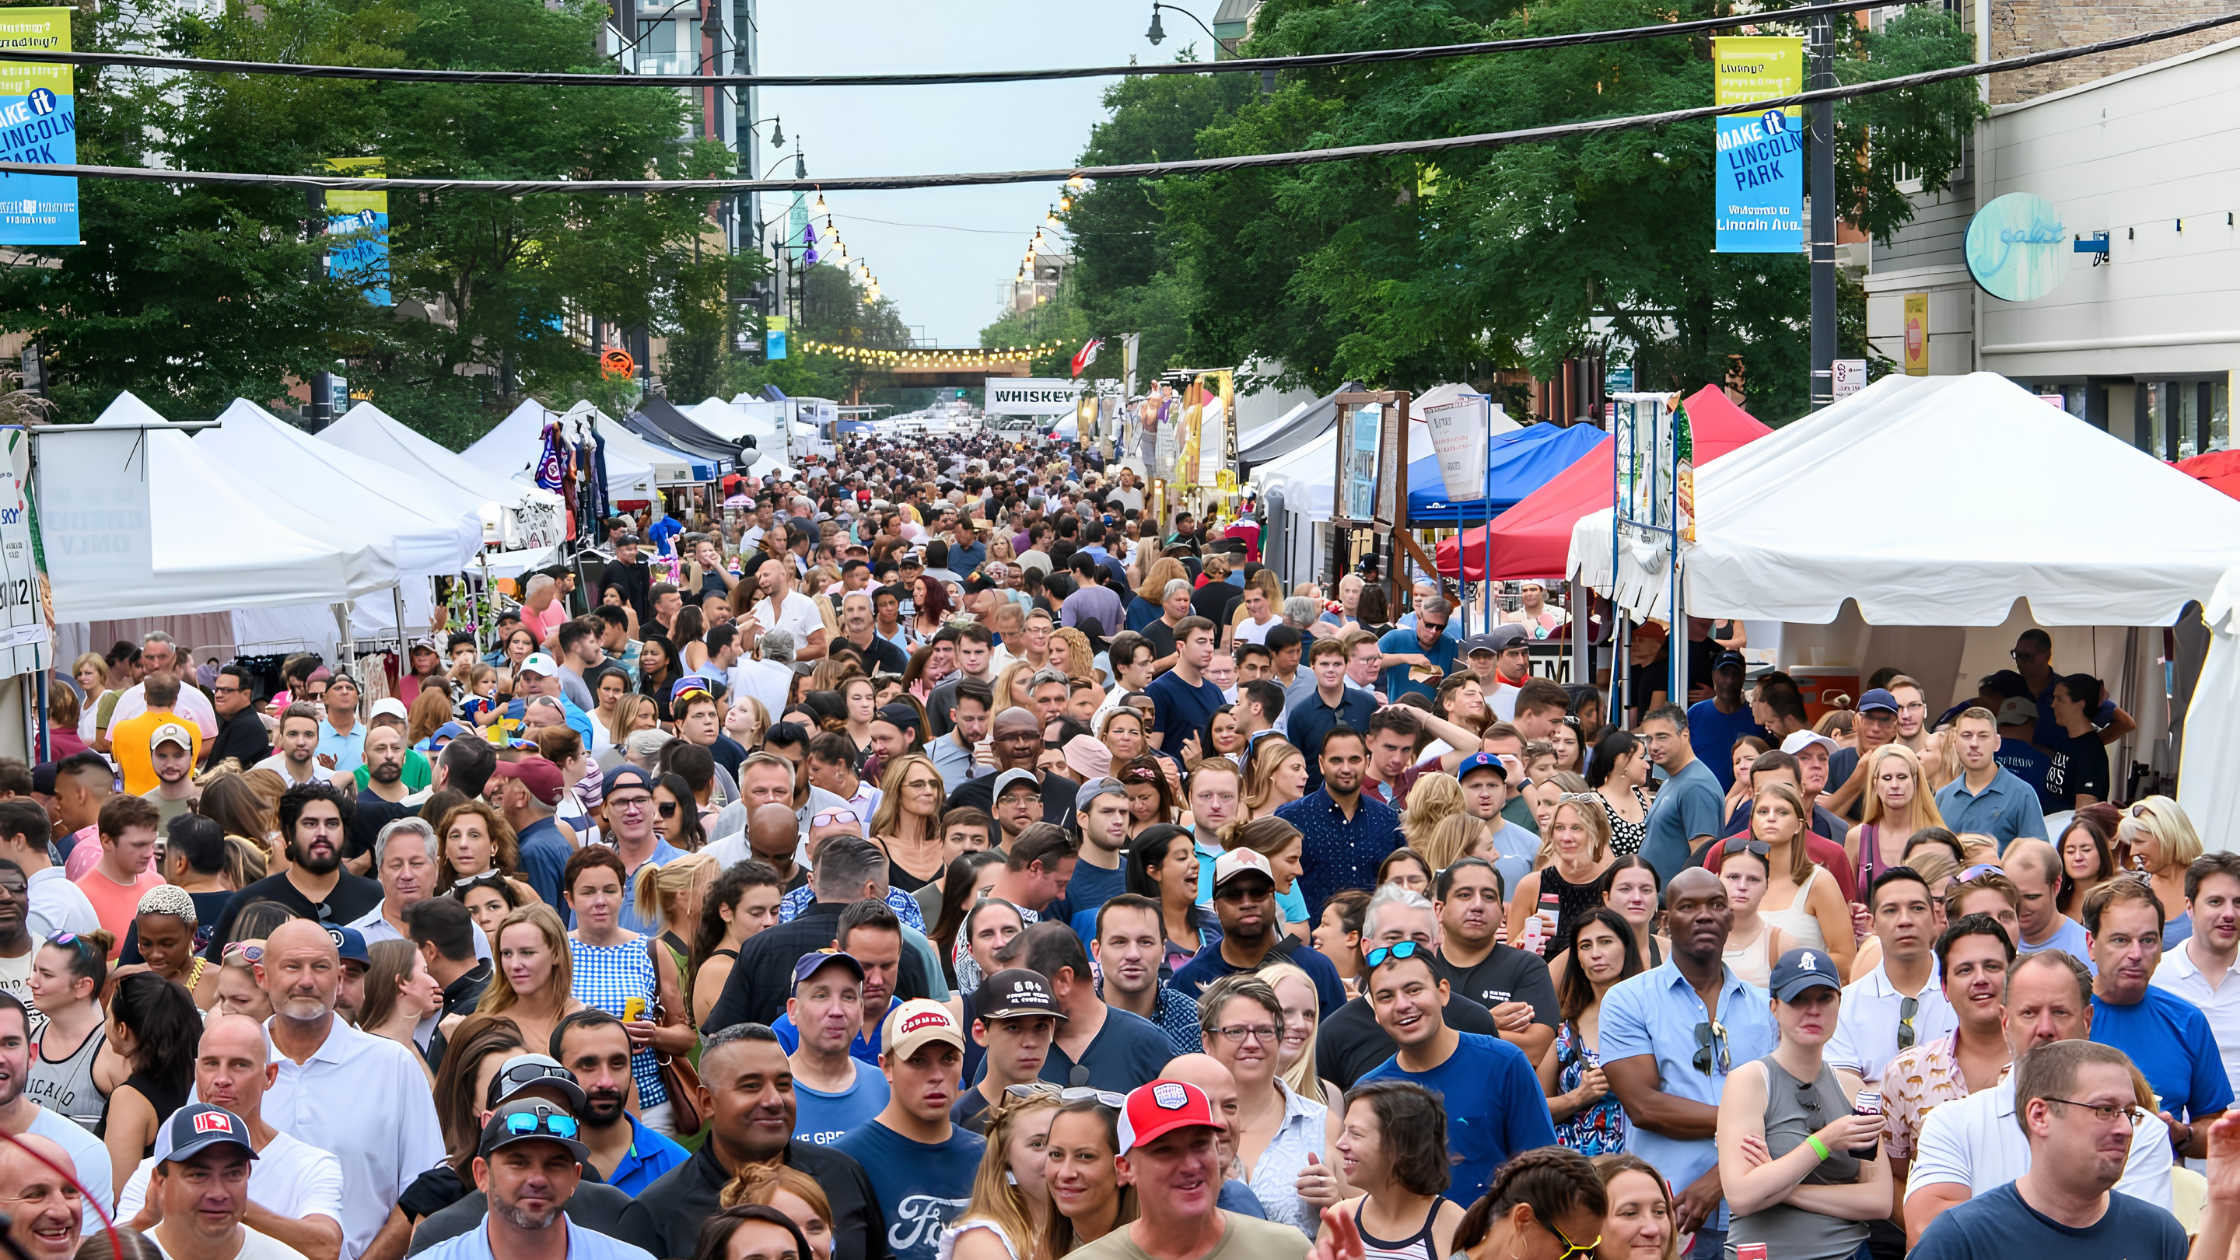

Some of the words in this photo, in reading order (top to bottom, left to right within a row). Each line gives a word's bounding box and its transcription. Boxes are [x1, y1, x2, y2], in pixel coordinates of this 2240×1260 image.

[31, 89, 53, 116] it
[0, 111, 76, 154] INCOLN
[1716, 122, 1763, 153] MAKE
[1764, 110, 1784, 136] it
[1728, 131, 1803, 170] LINCOLN
[1734, 159, 1785, 192] PARK
[1716, 218, 1768, 231] Lincoln
[995, 390, 1074, 403] WHISKEY
[1529, 659, 1570, 683] TM
